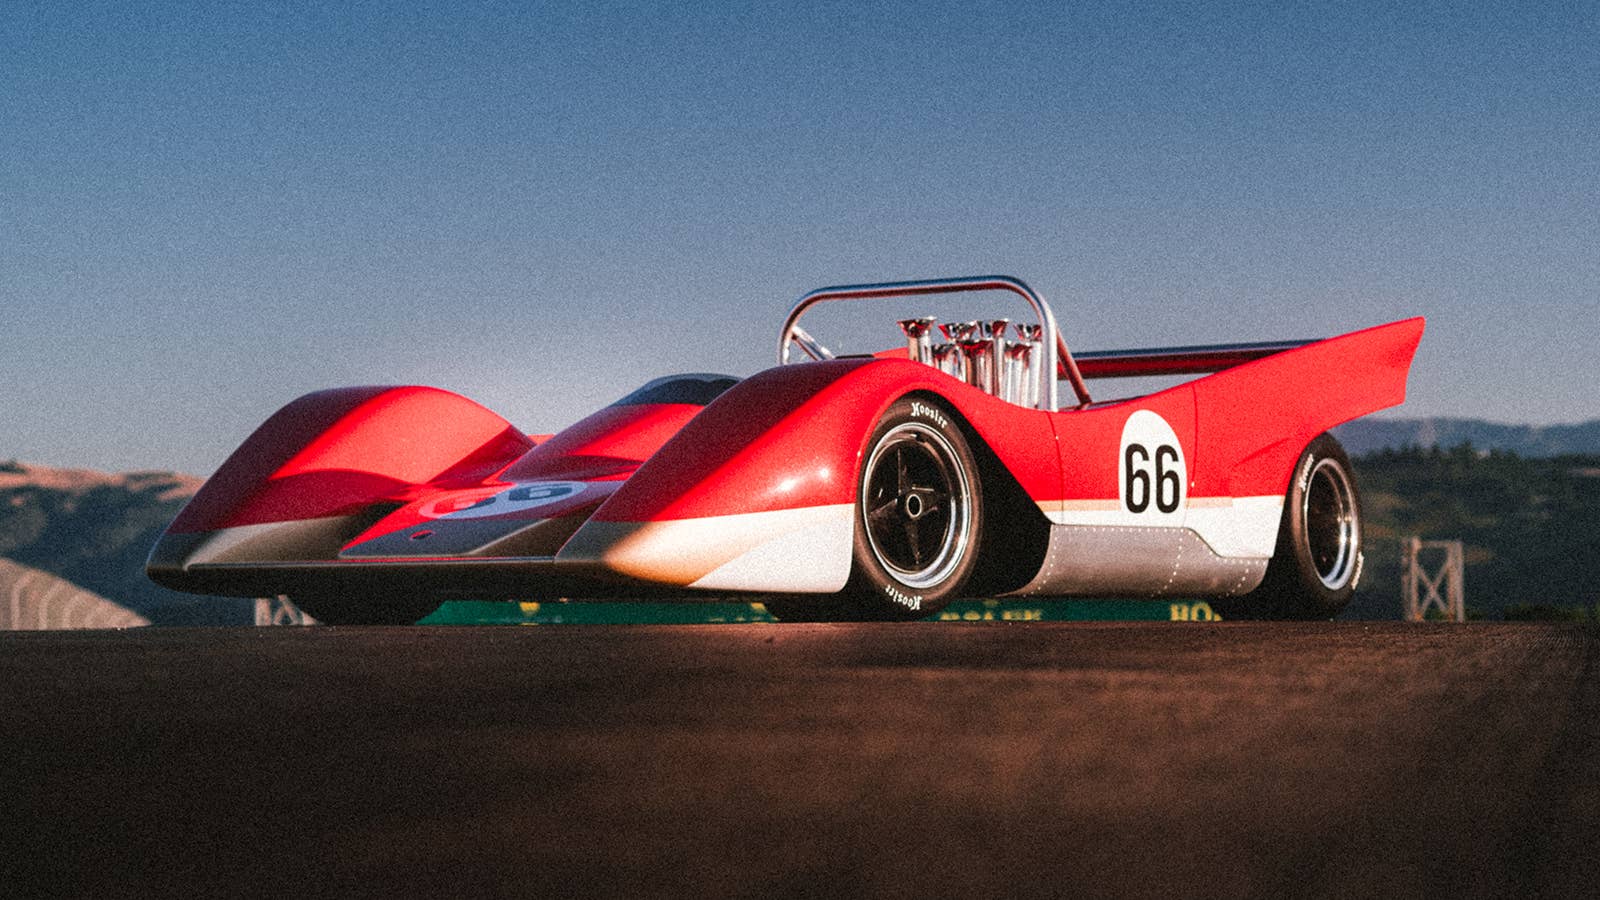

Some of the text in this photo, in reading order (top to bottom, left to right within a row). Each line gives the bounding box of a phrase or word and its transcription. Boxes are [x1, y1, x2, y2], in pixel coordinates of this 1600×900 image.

[911, 402, 948, 429] Hoosier
[1125, 443, 1180, 514] 66
[885, 584, 923, 611] Hoosier
